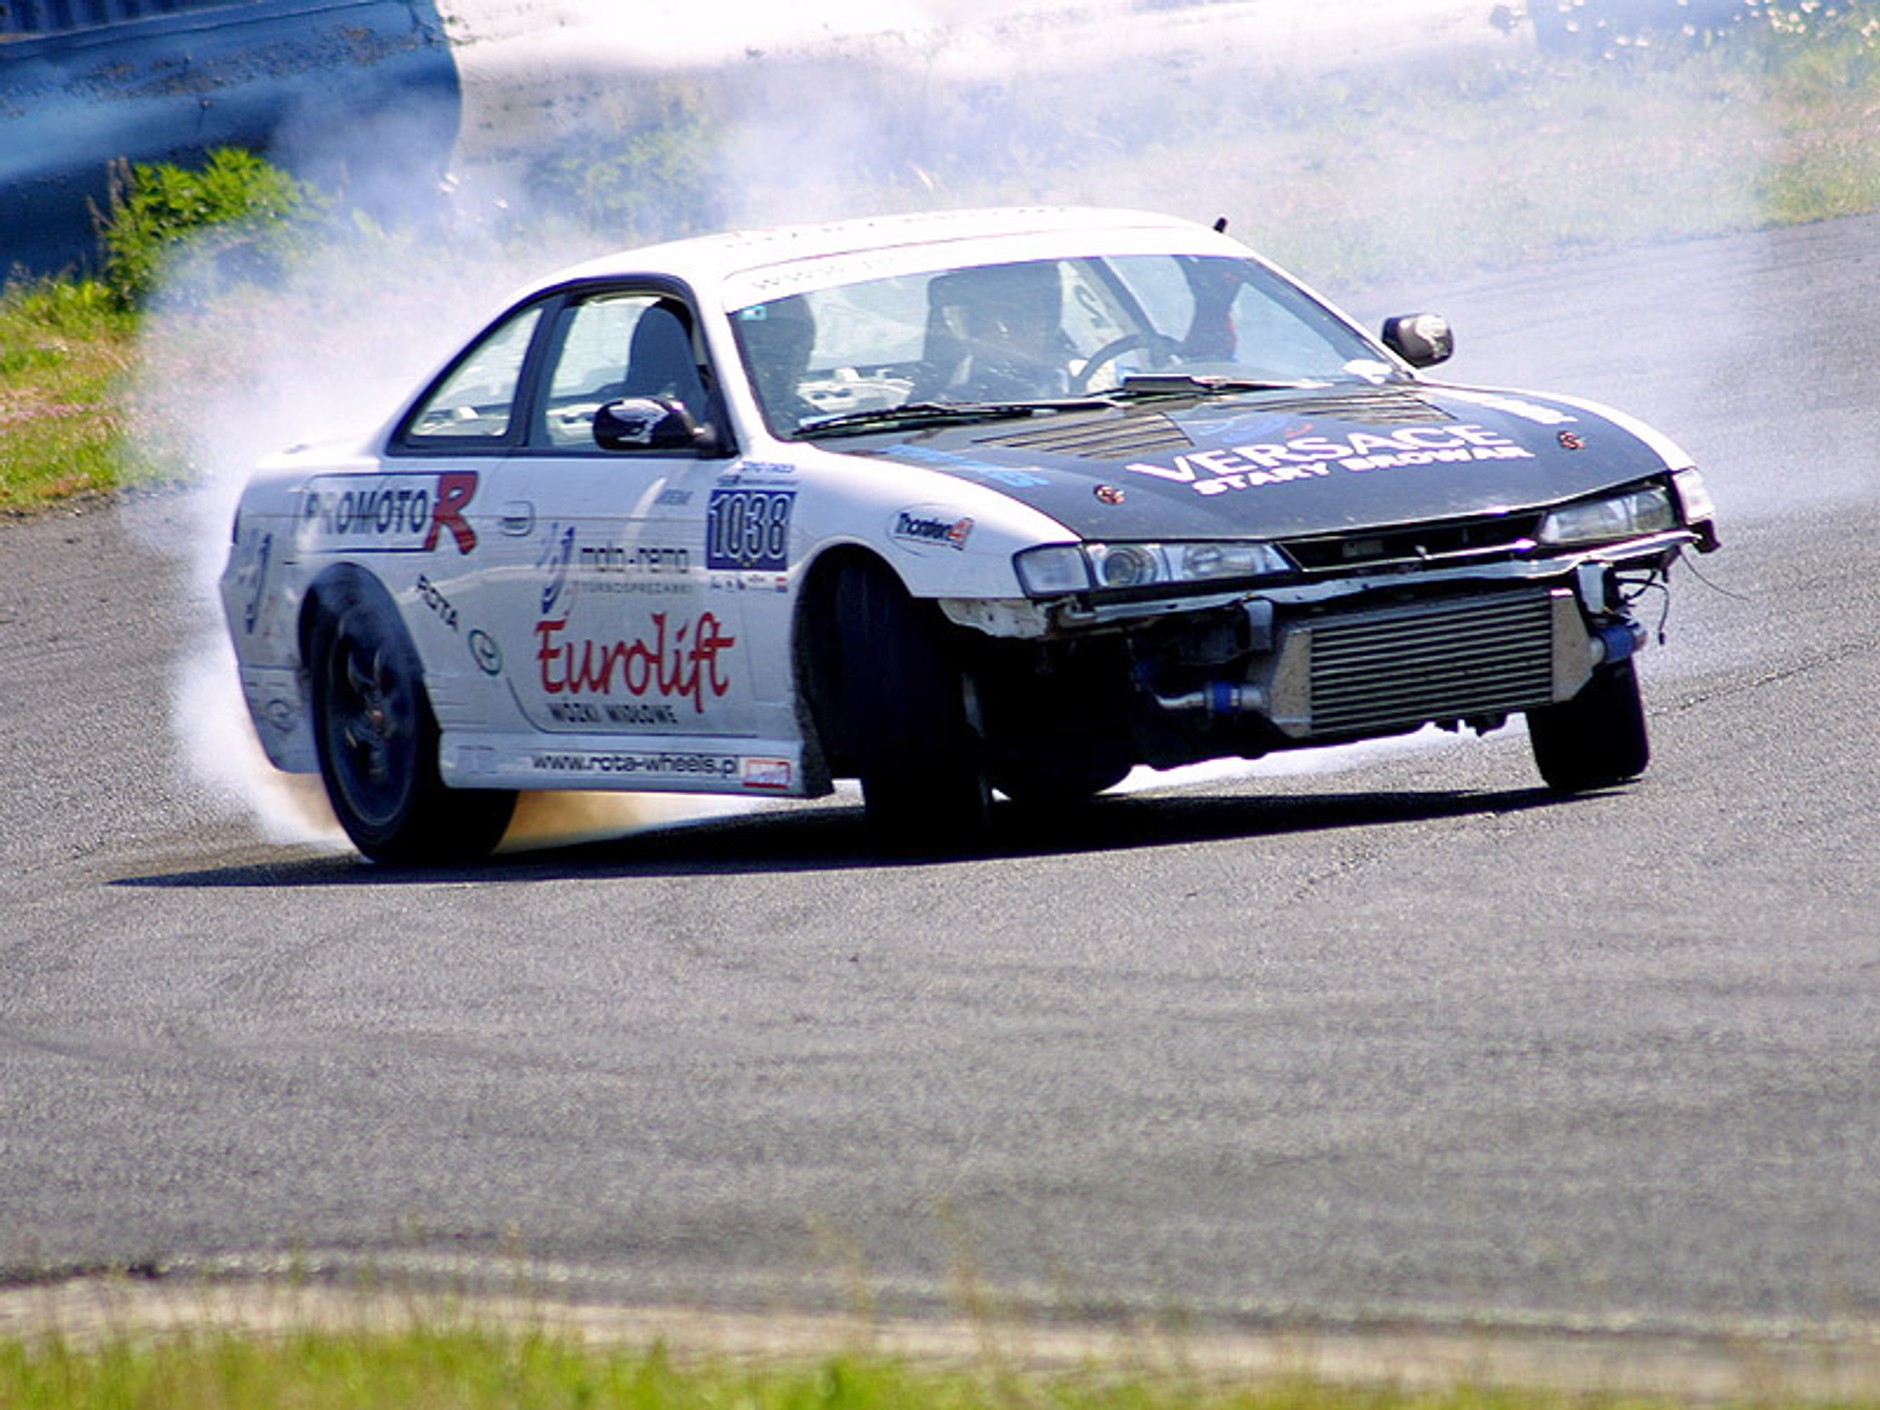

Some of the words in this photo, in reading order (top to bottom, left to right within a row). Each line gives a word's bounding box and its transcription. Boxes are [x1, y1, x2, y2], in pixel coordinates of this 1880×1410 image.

[1126, 424, 1514, 484] VERSACE
[1191, 461, 1330, 496] STARY
[708, 494, 792, 560] 1038
[416, 573, 459, 633] ROTA
[535, 611, 736, 715] Eurolift
[531, 751, 741, 779] www.rota-wheels.pl
